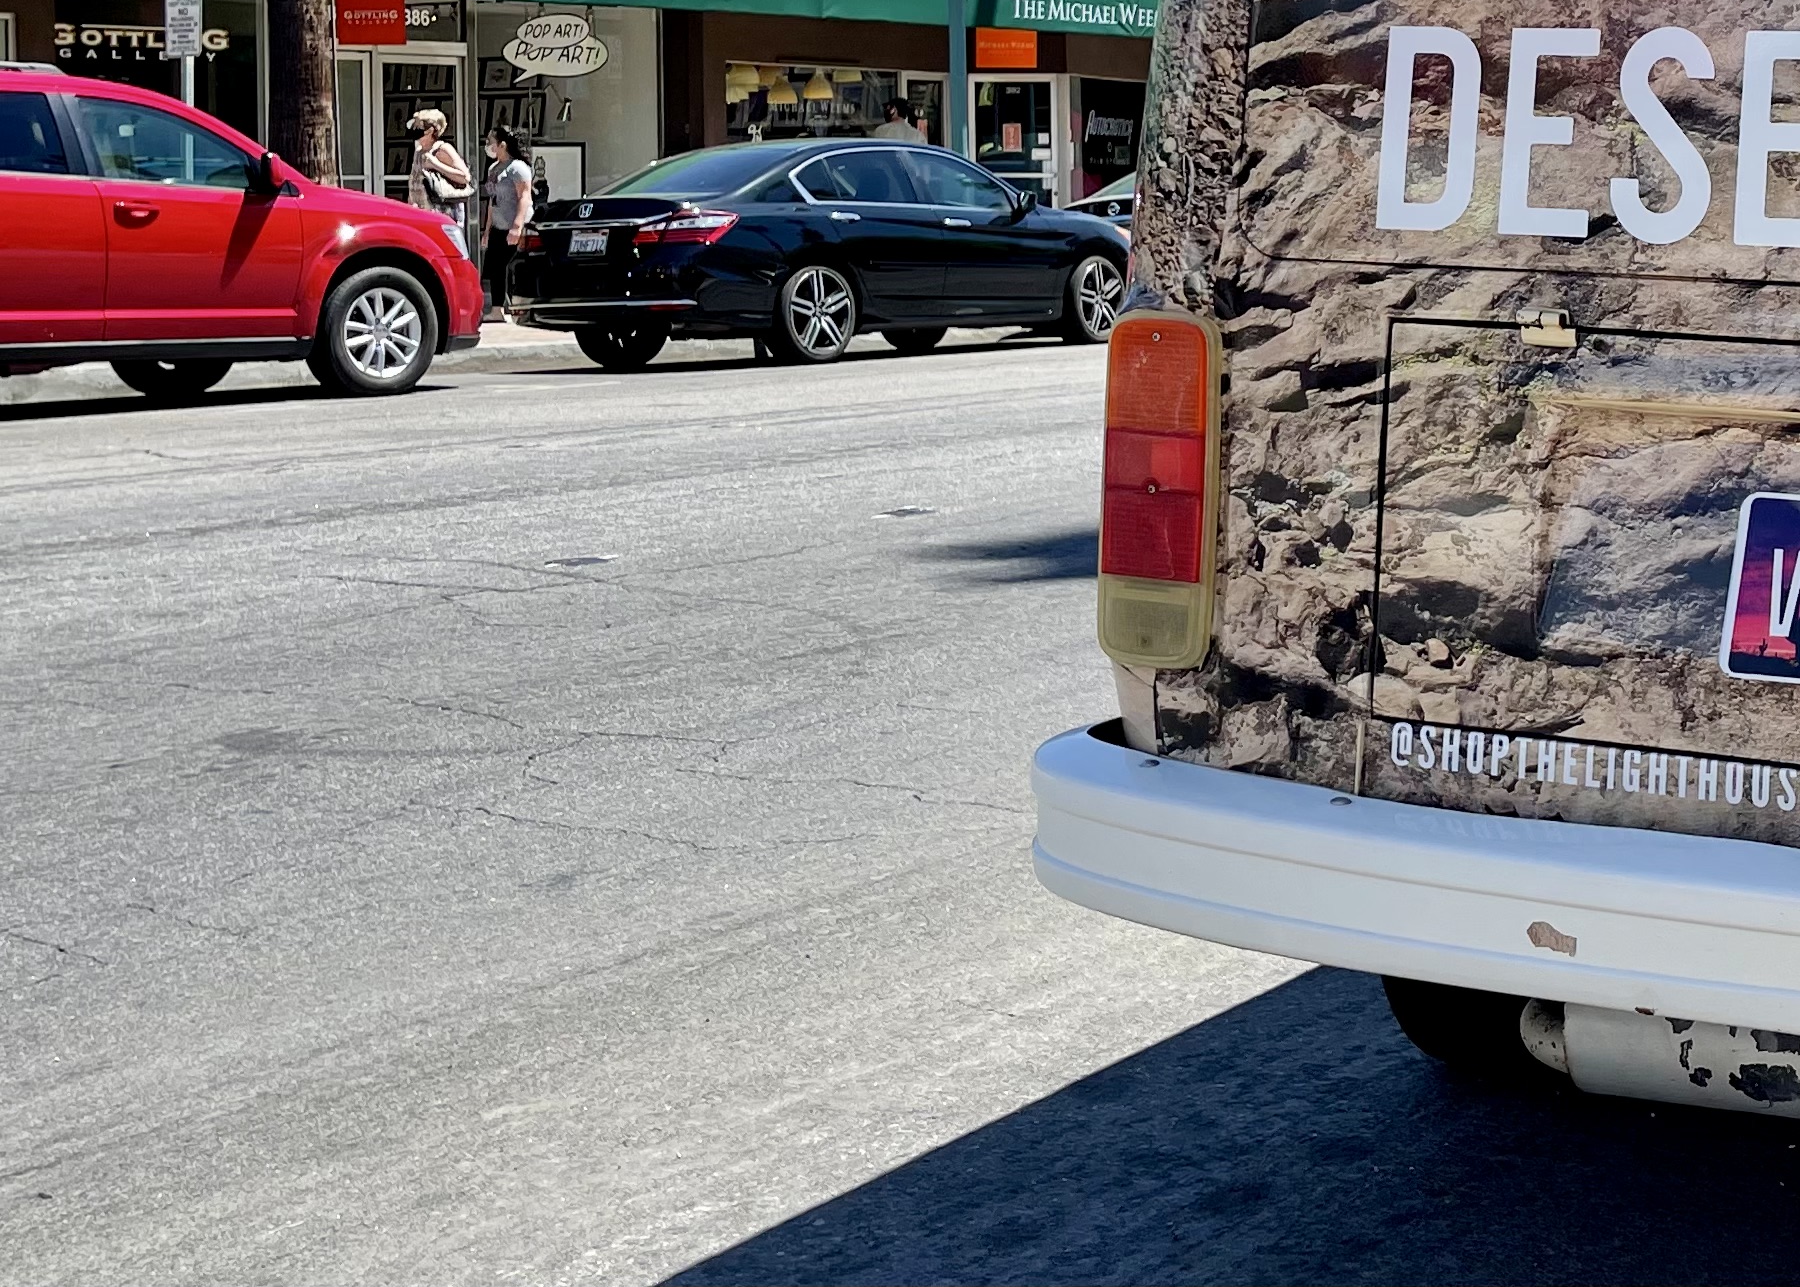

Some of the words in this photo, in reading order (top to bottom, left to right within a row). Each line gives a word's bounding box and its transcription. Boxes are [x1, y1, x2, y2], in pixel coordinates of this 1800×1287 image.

[524, 23, 551, 38] POP
[553, 23, 584, 38] ART!
[59, 48, 216, 62] GALLEY
